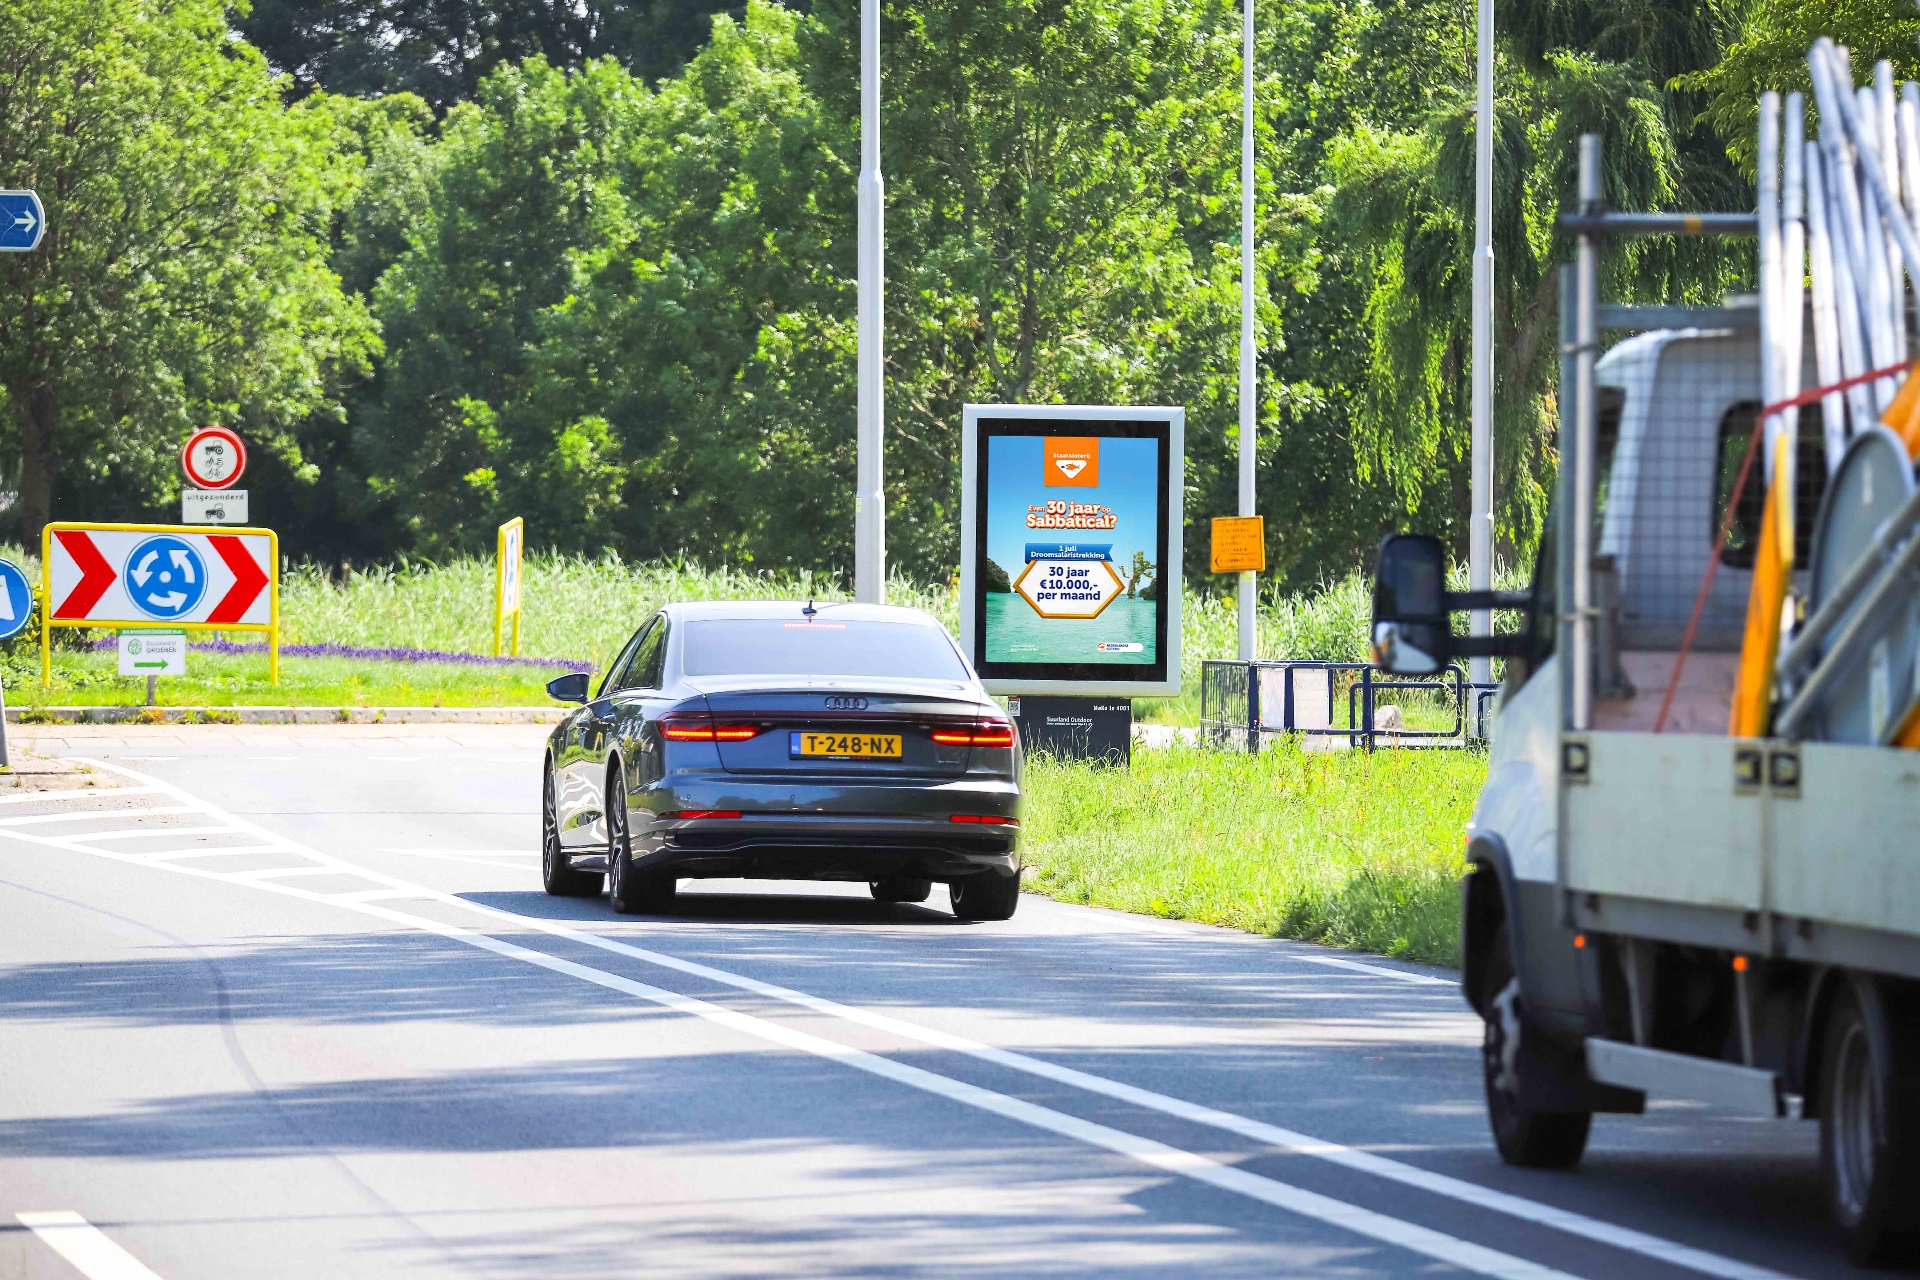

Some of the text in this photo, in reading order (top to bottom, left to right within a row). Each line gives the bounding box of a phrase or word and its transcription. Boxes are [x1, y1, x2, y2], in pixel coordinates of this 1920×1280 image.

[187, 494, 245, 502] uitgezonderd
[1046, 500, 1066, 515] 30
[1068, 500, 1101, 517] jaar
[1026, 513, 1118, 529] Sabbatical?
[1030, 551, 1105, 560] Droomsalaristrekking
[1049, 566, 1090, 579] 30 jaar
[1037, 591, 1101, 602] per maand
[807, 735, 895, 754] T-248-NX
